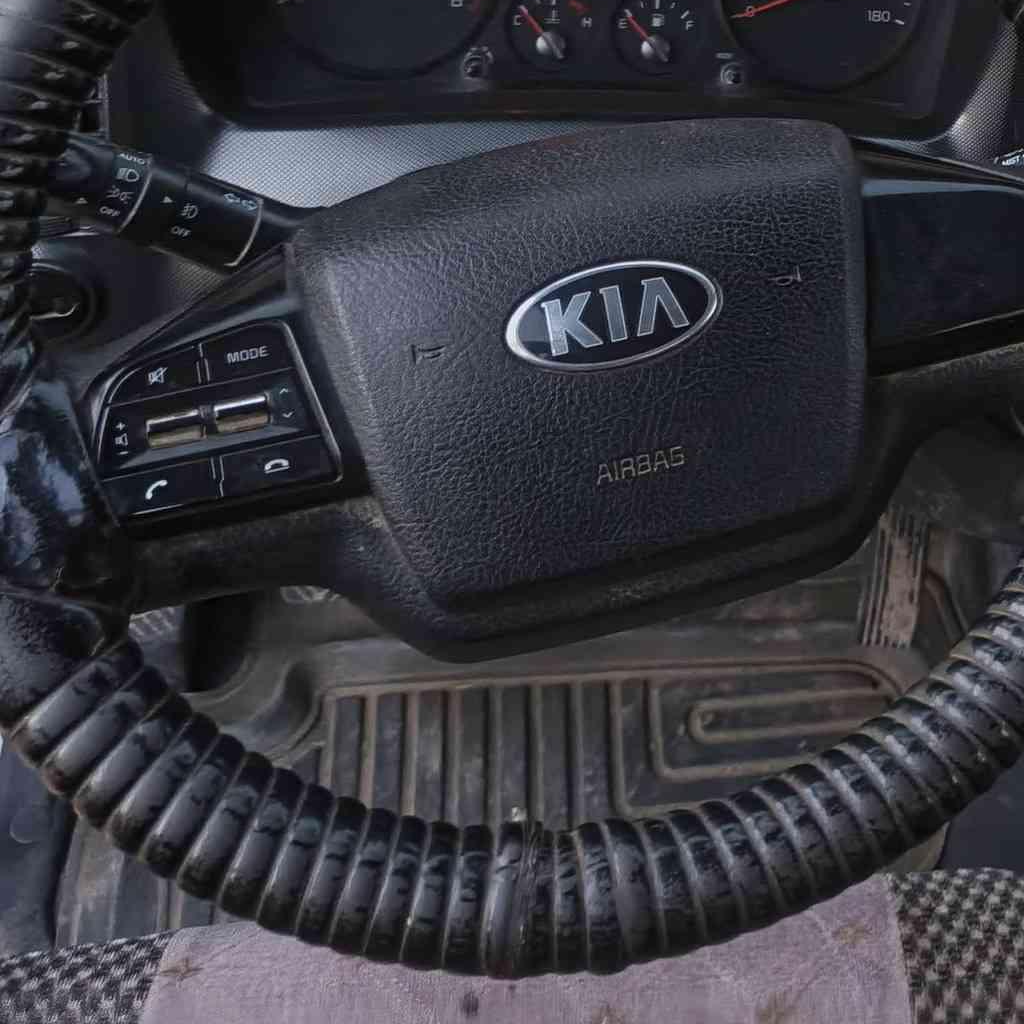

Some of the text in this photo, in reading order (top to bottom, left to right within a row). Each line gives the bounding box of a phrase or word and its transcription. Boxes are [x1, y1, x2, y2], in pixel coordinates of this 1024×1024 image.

[868, 10, 890, 22] 180
[582, 18, 592, 27] H
[619, 19, 628, 29] E
[686, 21, 695, 30] F
[100, 206, 121, 217] OFF
[170, 226, 192, 238] OFF
[540, 276, 690, 357] KIA
[226, 345, 271, 364] MODE
[596, 446, 685, 485] AIRBAG
